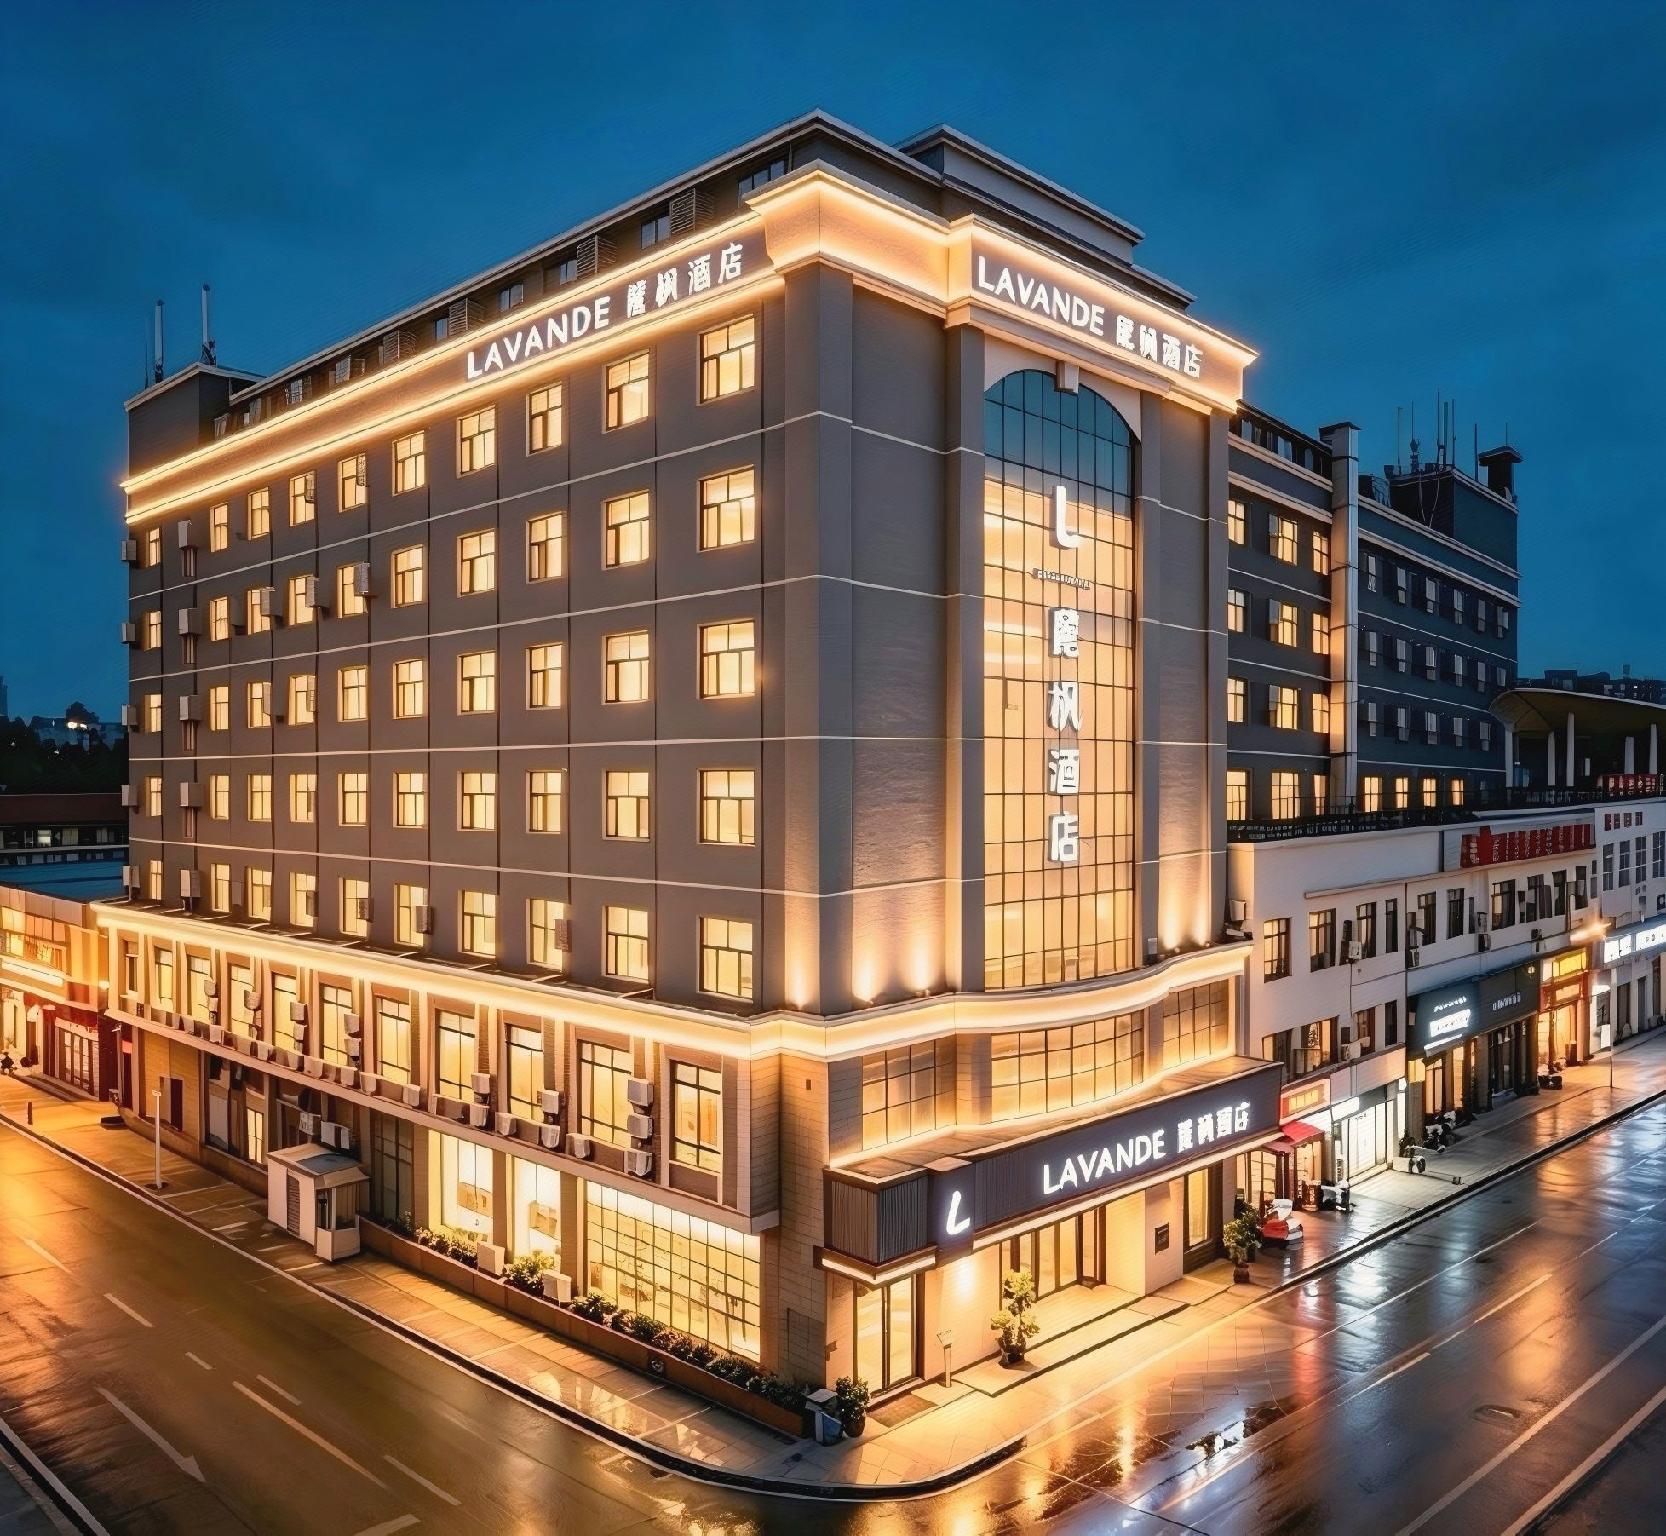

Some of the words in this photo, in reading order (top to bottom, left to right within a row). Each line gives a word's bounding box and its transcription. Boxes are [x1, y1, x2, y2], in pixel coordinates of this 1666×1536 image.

[978, 256, 1105, 336] LAVANDE
[467, 295, 610, 379] LAVANDE
[1043, 1129, 1166, 1195] LAVANDE
